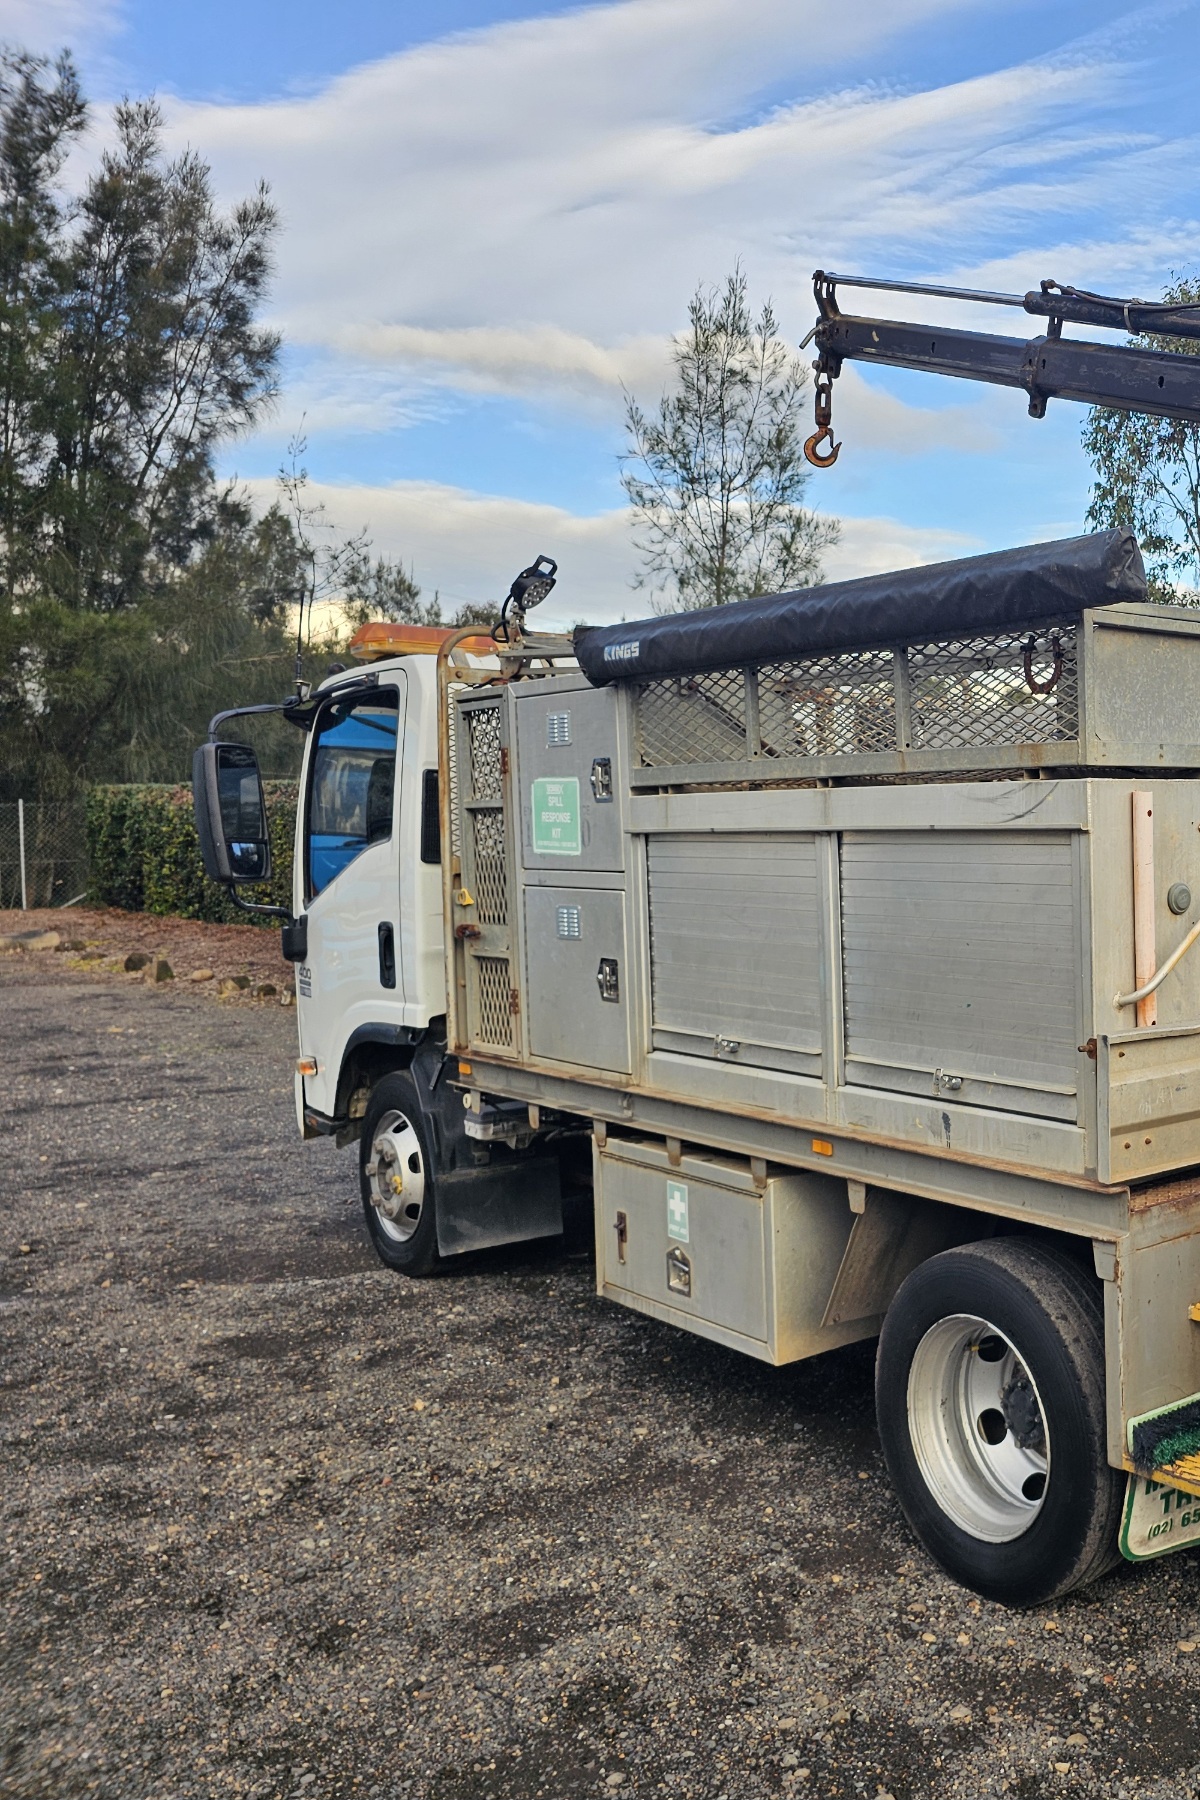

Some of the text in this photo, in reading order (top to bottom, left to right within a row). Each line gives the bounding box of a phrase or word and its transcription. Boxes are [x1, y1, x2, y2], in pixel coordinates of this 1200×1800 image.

[603, 641, 640, 661] KINGS
[547, 795, 564, 807] SPILL
[541, 811, 572, 823] RESPONSE
[1147, 1517, 1173, 1540] (02)
